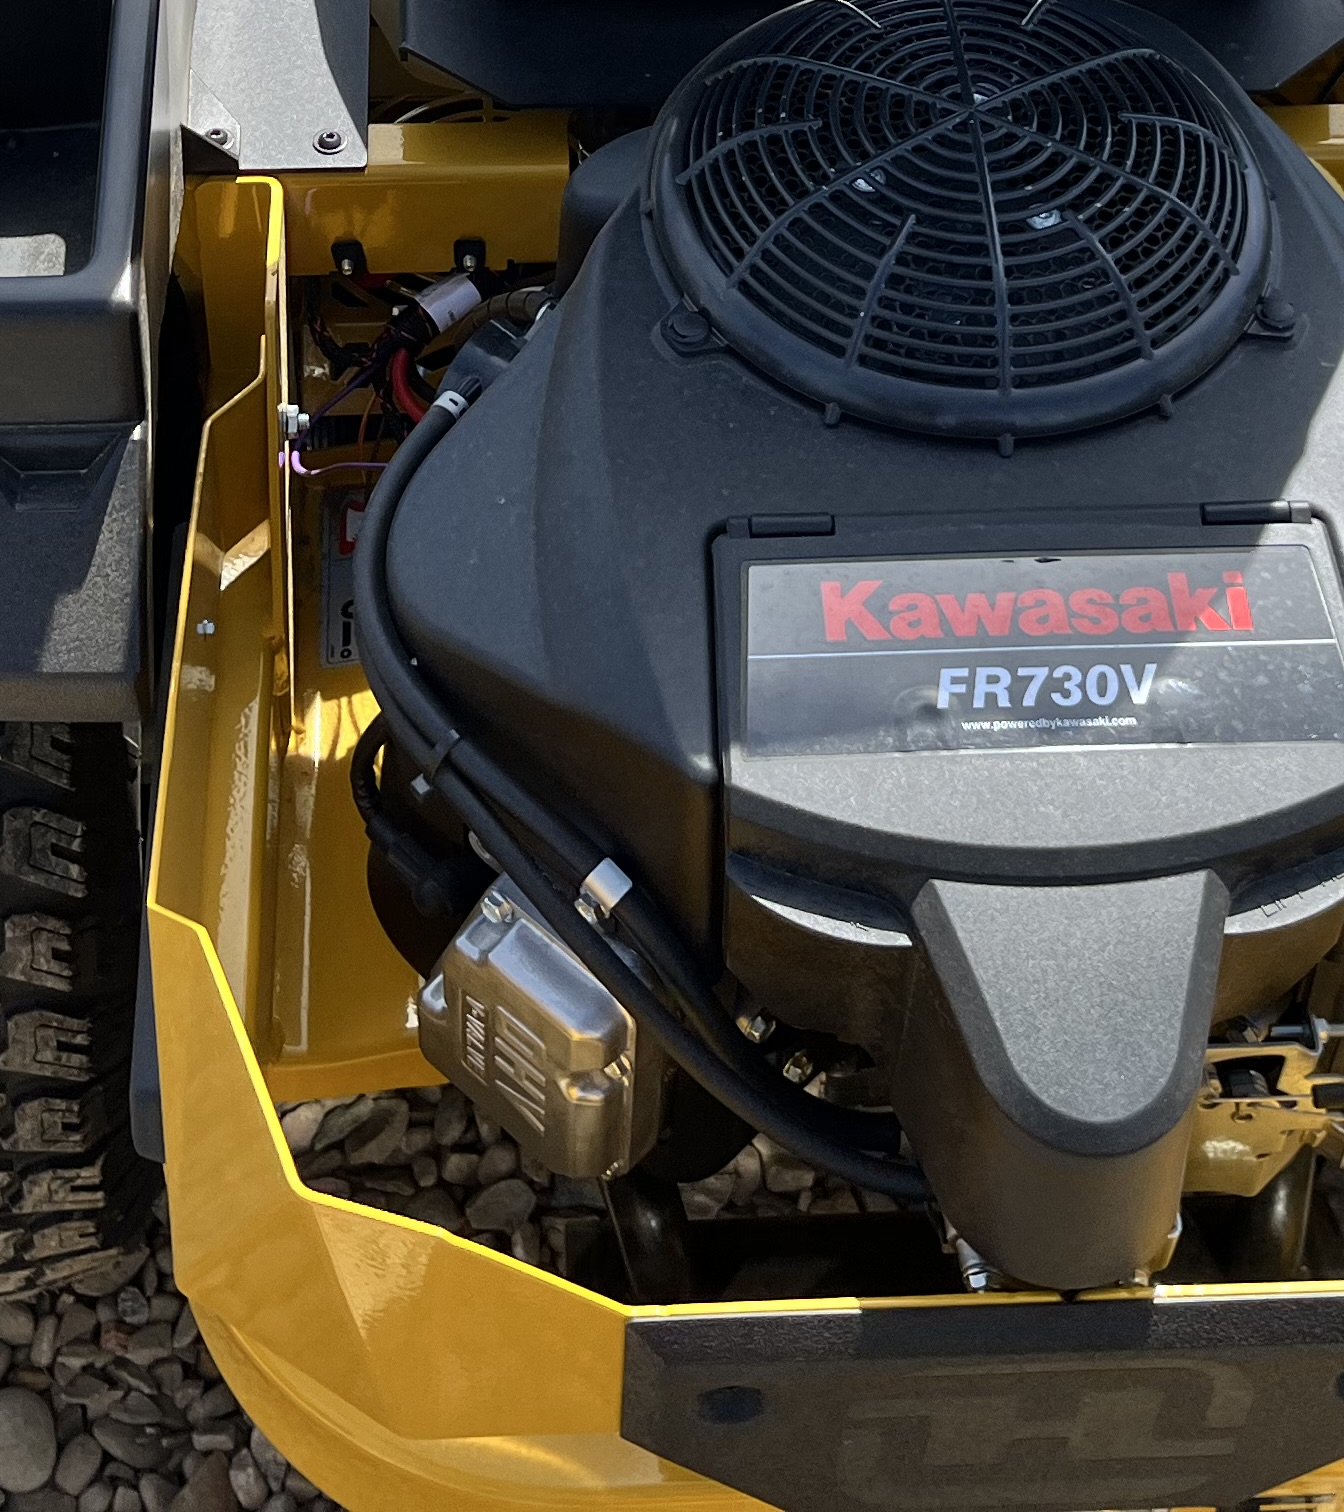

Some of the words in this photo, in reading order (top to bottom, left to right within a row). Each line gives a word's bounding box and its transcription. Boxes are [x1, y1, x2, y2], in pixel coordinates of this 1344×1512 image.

[819, 571, 1254, 643] Kawasaki
[936, 662, 1158, 709] FR730V
[960, 715, 1137, 732] www.poweredbykawasaki.com
[493, 1004, 546, 1137] OHV
